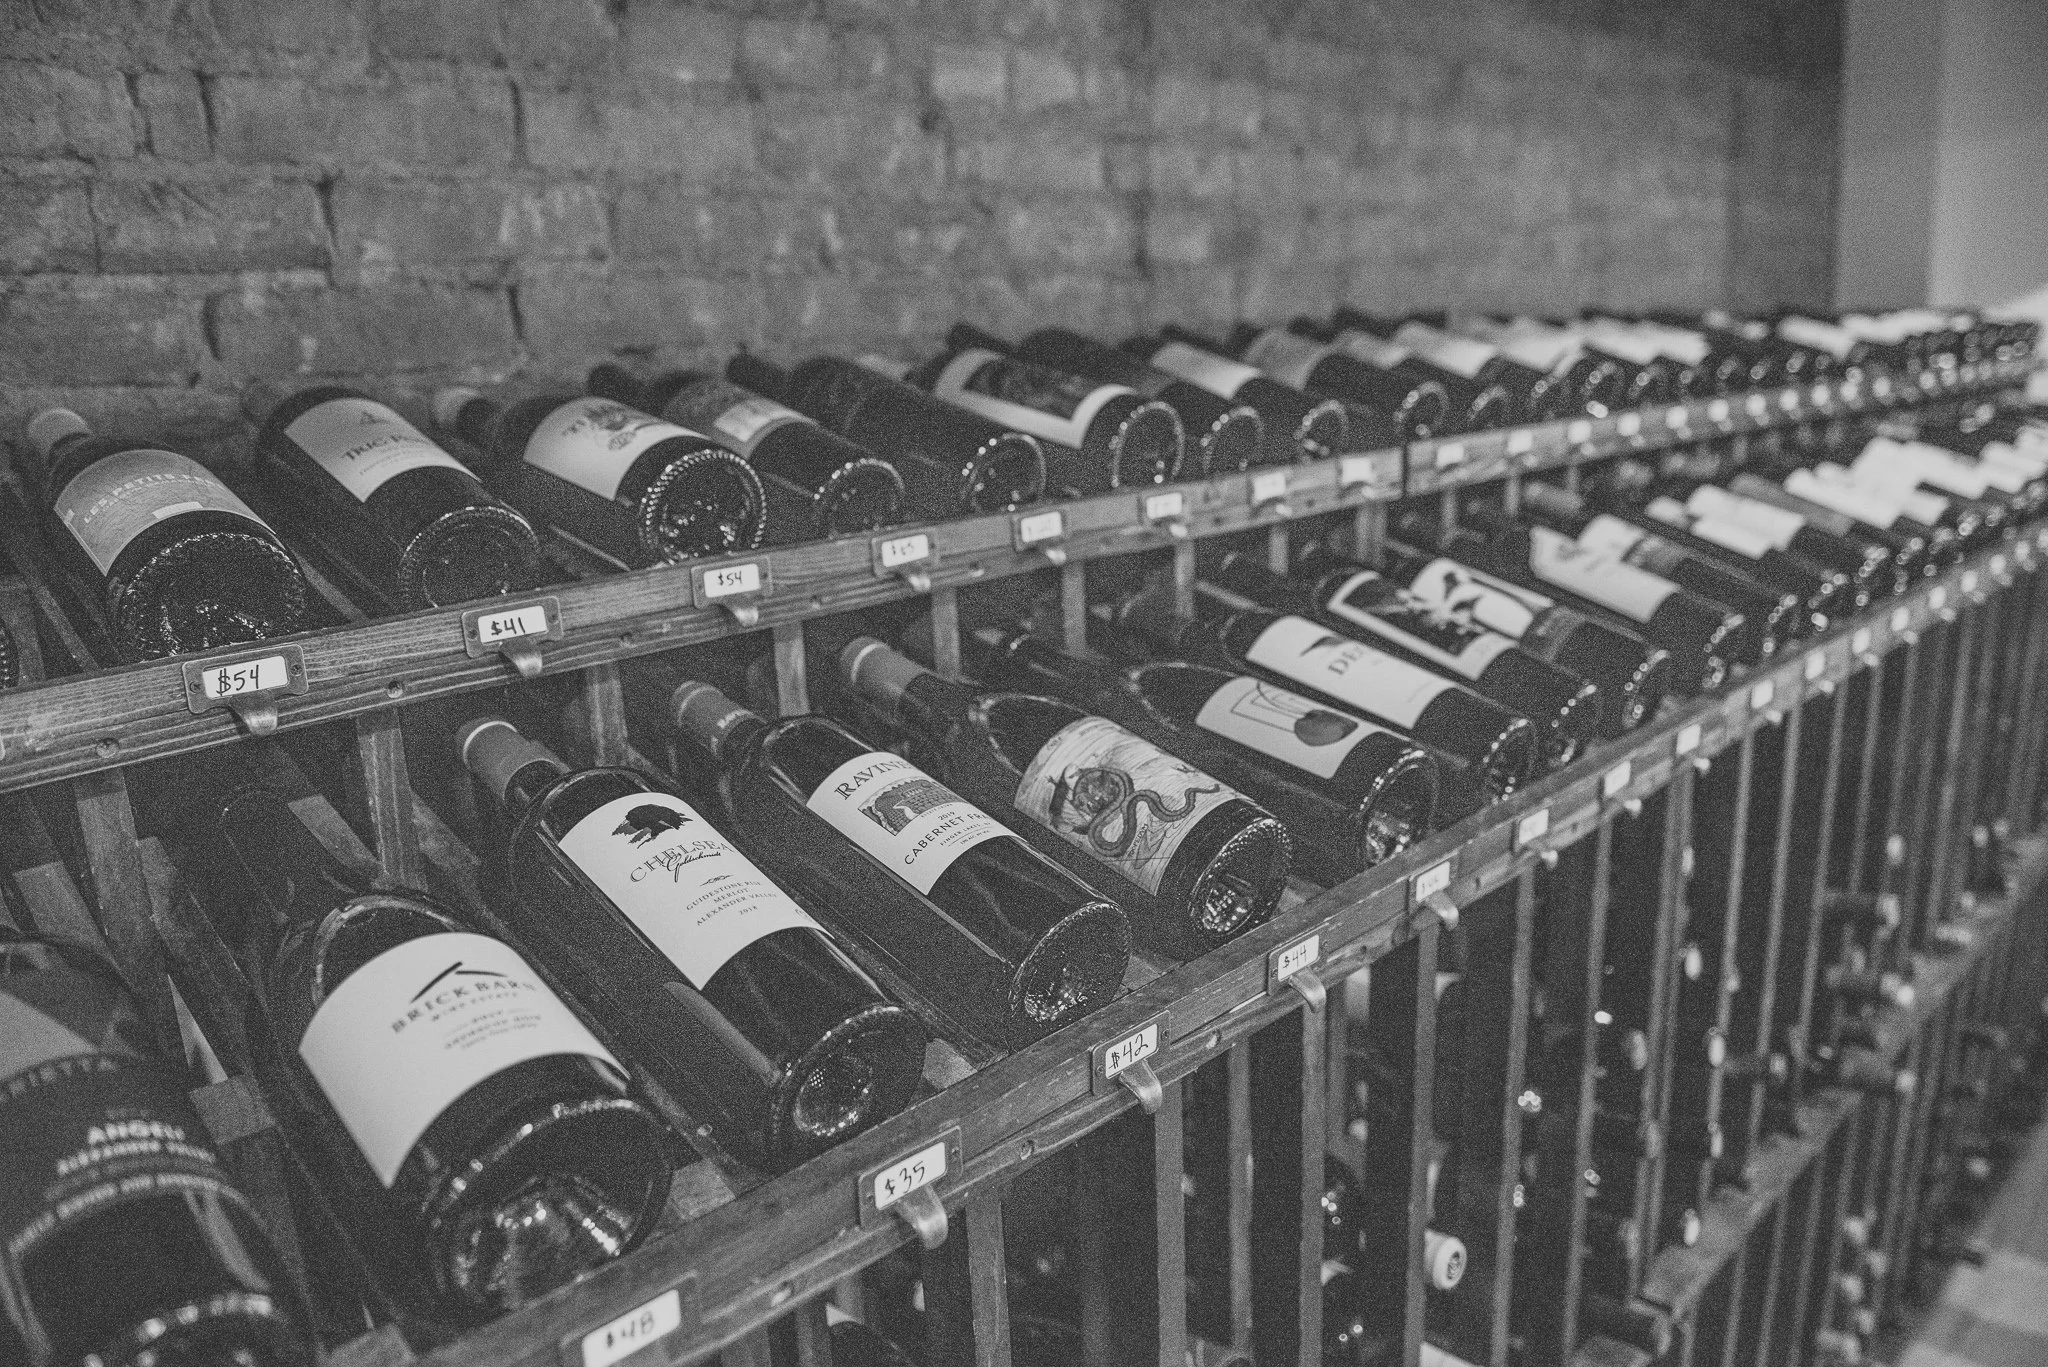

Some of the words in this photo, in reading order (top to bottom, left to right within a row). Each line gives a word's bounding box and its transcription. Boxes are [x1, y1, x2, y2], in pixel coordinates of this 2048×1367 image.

[717, 570, 743, 586] $54
[491, 617, 526, 636] $41
[216, 664, 259, 697] $54
[938, 811, 956, 821] 2019
[904, 816, 965, 865] CABERNET
[630, 840, 734, 883] CHELSEA
[686, 881, 743, 911] GUIDESTONE
[697, 896, 746, 926] ALEXANDER
[713, 888, 748, 904] MERLOT
[1282, 944, 1307, 969] $44
[392, 987, 469, 1034] BRICK
[1109, 1033, 1149, 1069] $42
[884, 1160, 926, 1196] $35
